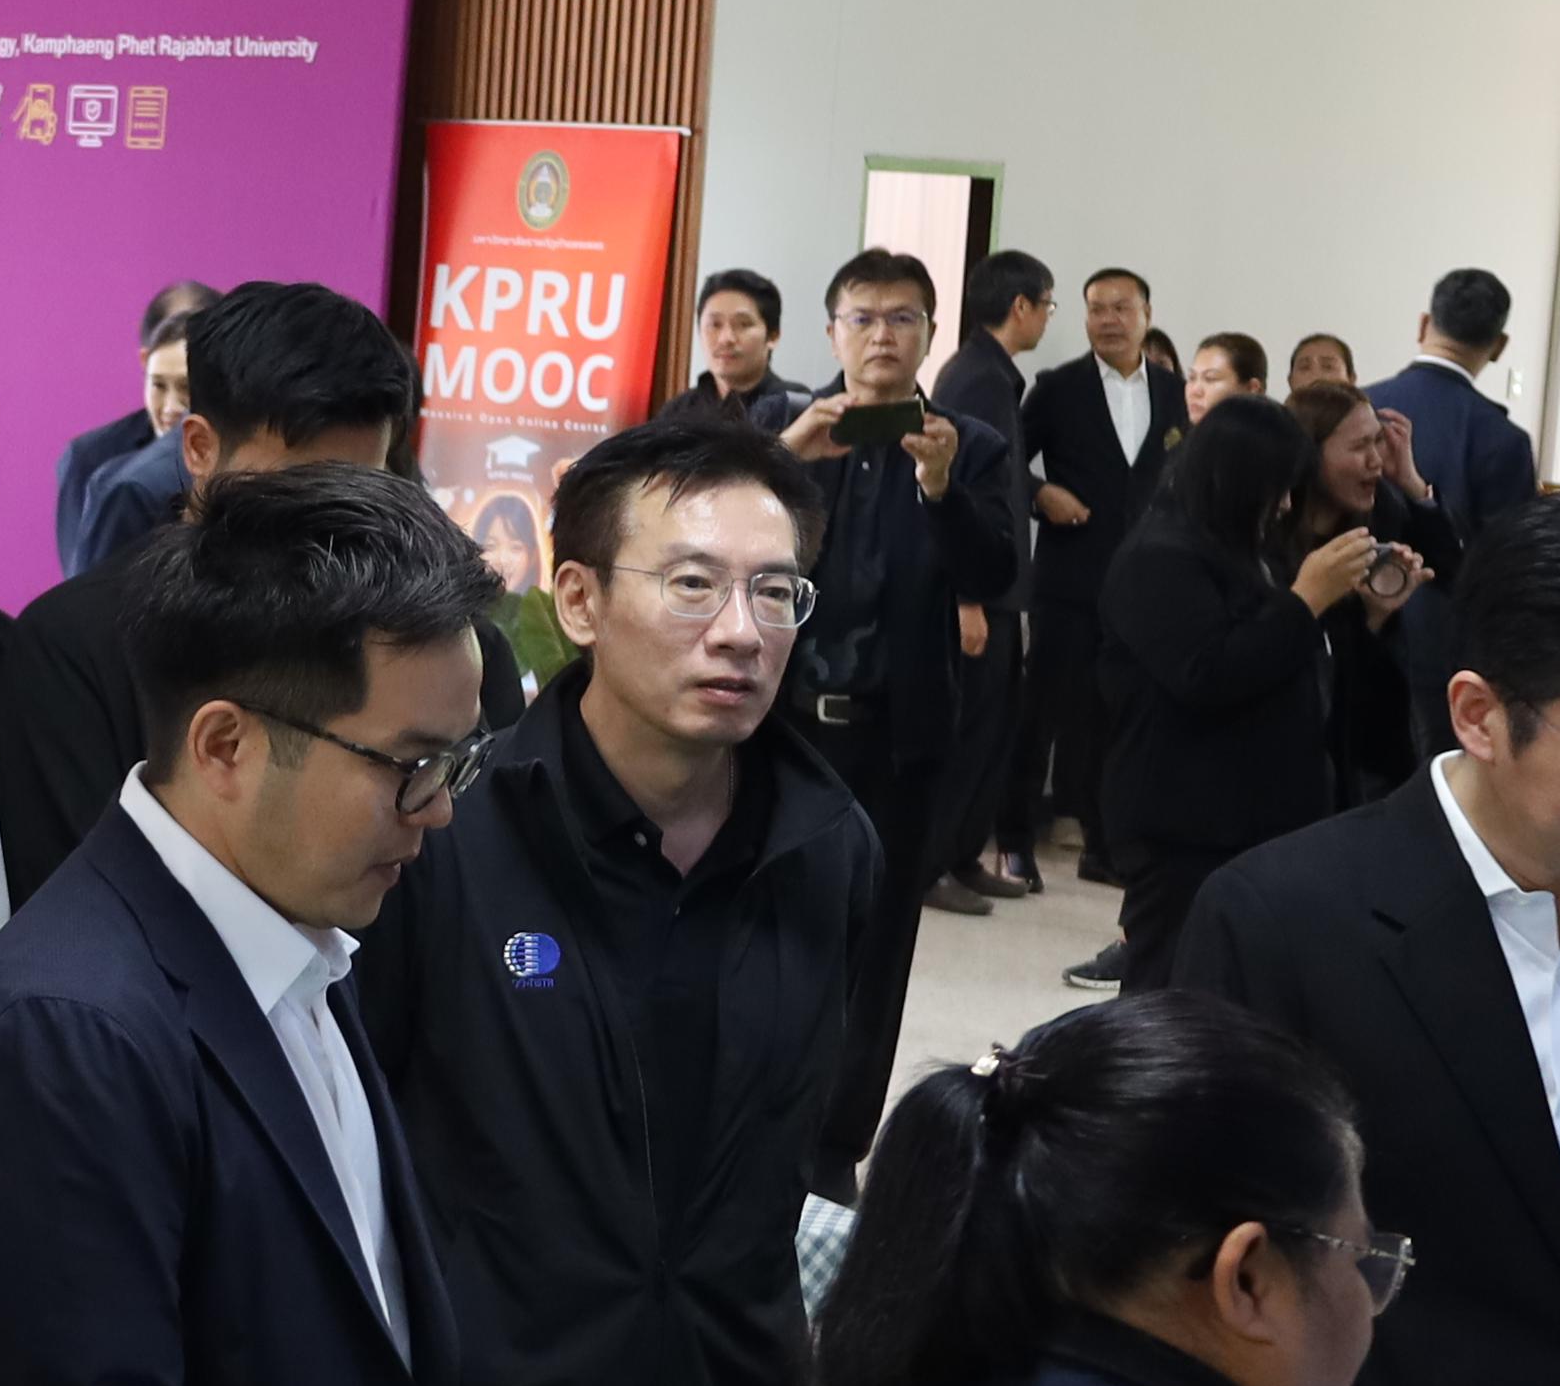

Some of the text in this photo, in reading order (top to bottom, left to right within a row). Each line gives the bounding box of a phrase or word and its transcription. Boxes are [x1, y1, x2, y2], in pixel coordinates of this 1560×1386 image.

[22, 33, 115, 61] Kamphaeng
[116, 34, 157, 57] Phet
[159, 34, 232, 62] Rajabhat
[233, 35, 319, 64] University
[429, 262, 626, 341] KPRU
[421, 342, 615, 413] MOOC
[479, 412, 512, 426] Open
[516, 415, 559, 430] Online
[563, 418, 609, 434] Course
